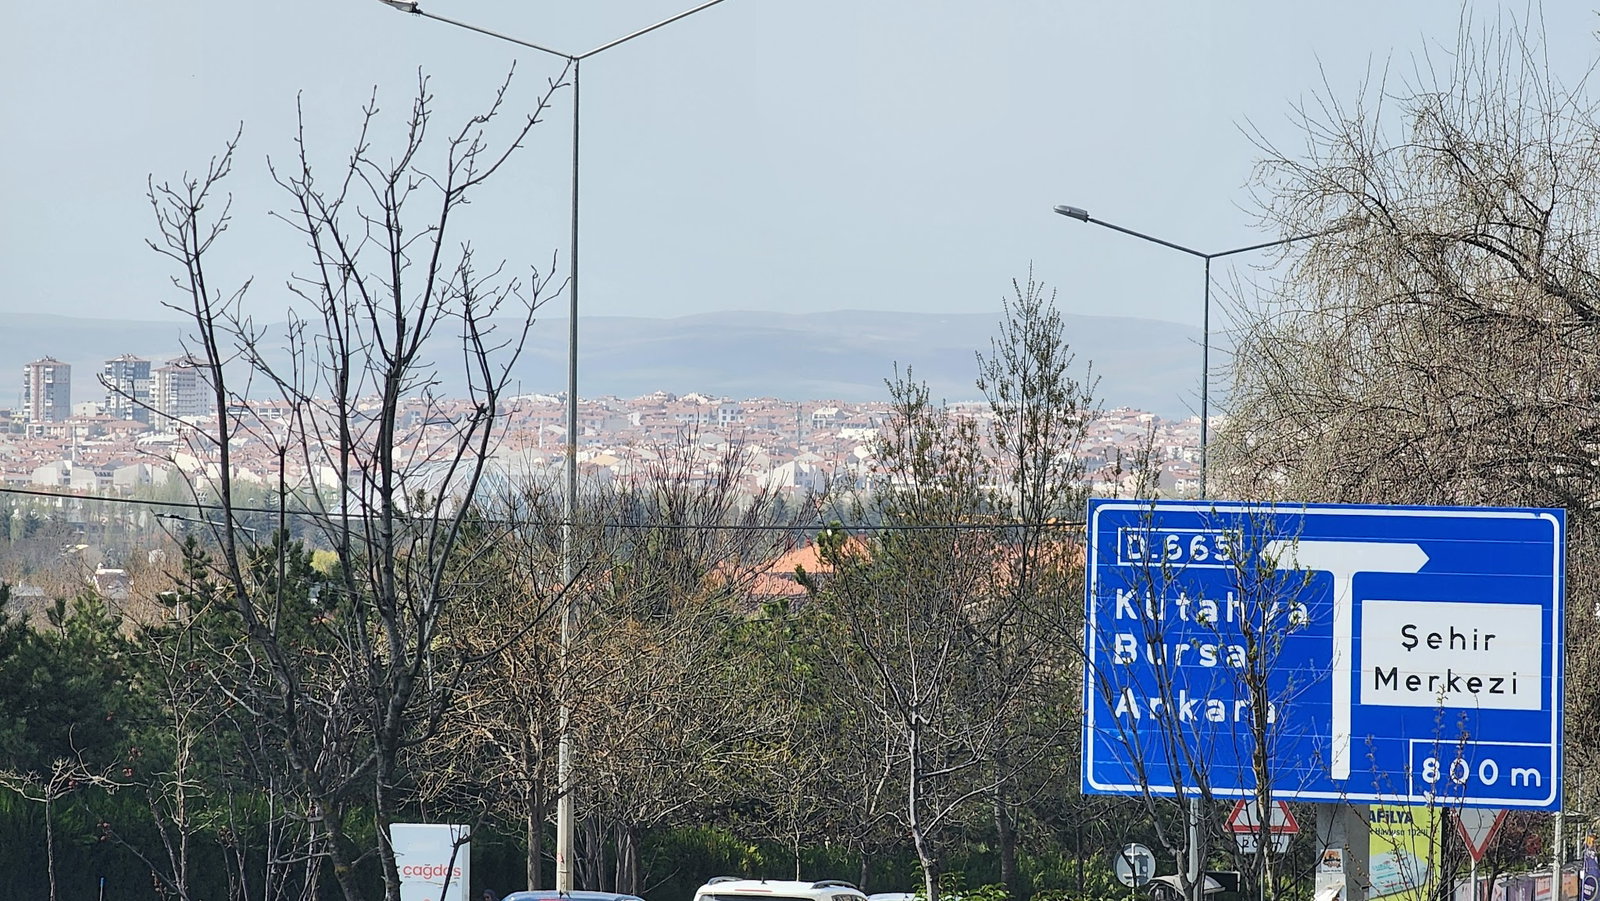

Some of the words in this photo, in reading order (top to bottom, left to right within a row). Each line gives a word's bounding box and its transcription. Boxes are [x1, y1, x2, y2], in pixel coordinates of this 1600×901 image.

[1127, 534, 1231, 561] D.665
[1114, 633, 1247, 667] Bursa
[1401, 624, 1496, 652] Şehir
[1375, 666, 1517, 694] Merkezi
[1421, 757, 1498, 785] 800
[1510, 768, 1541, 787] m
